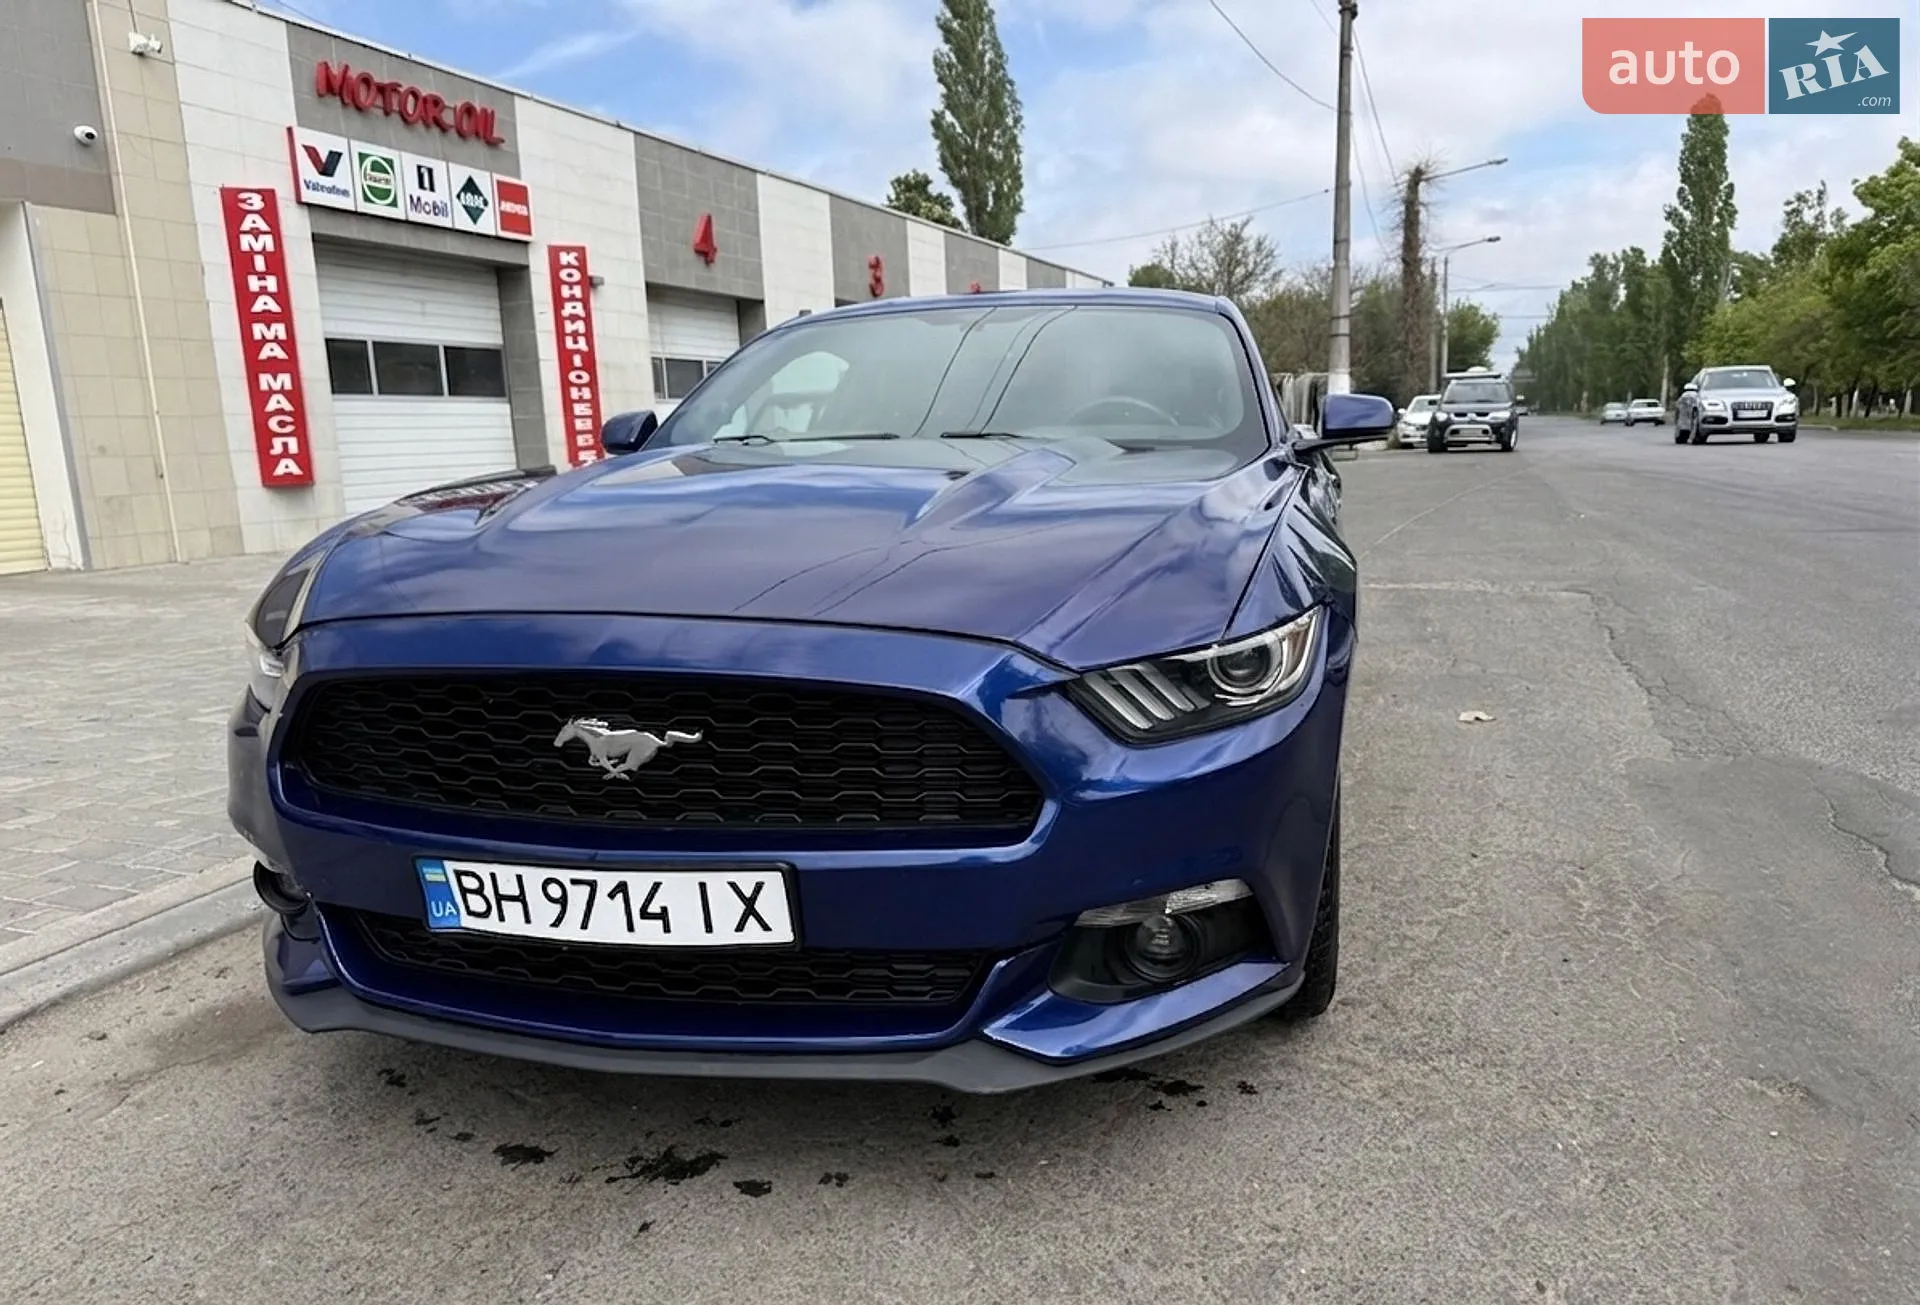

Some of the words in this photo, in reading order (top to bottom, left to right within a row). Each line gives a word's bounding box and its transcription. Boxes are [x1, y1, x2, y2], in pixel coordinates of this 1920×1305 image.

[315, 60, 451, 133] MOTOR
[454, 101, 505, 147] OIL
[409, 193, 449, 218] Mobil
[236, 191, 282, 313] ЗАМІНА
[694, 213, 717, 266] 4
[868, 254, 885, 298] 3
[257, 372, 304, 477] МАСЛА
[431, 900, 458, 919] UA
[453, 868, 532, 925] BH
[541, 876, 672, 934] 9714
